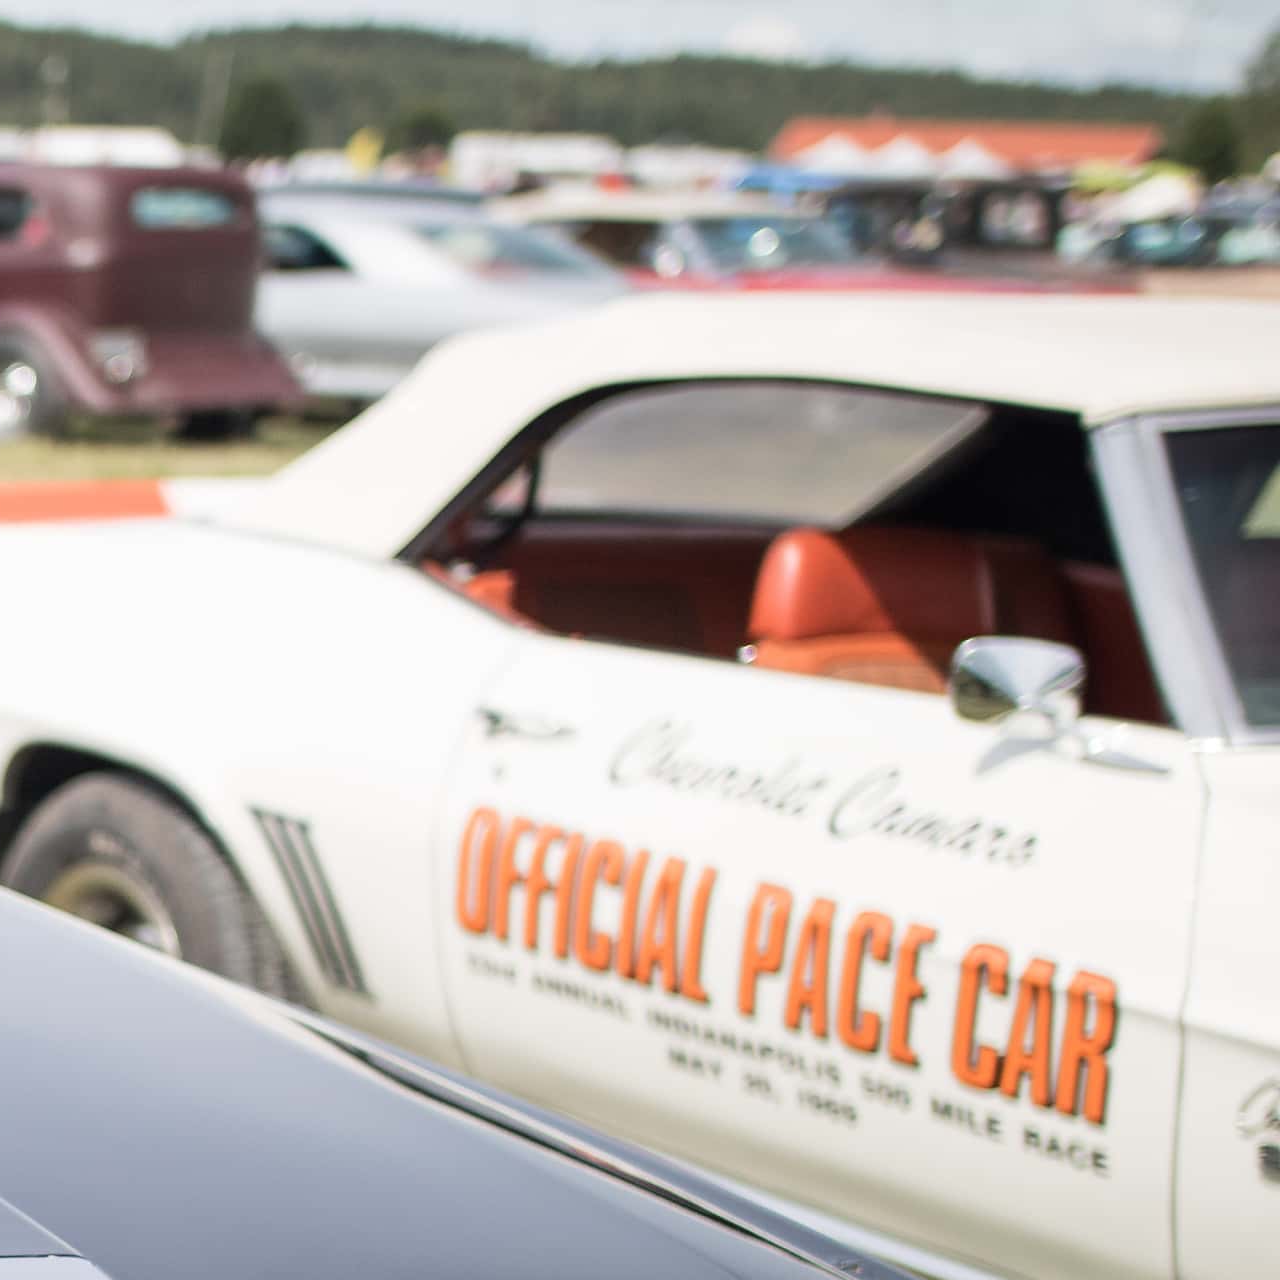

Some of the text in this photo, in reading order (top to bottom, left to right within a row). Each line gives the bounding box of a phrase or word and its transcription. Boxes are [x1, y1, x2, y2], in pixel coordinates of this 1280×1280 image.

[827, 767, 1038, 867] Camaro
[456, 806, 1118, 1126] OFFICIAL PACE CAR
[648, 1009, 840, 1084] INDIANAPOLIS
[860, 1071, 912, 1110] 500
[930, 1097, 1004, 1139] MILE
[1024, 1127, 1111, 1177] RACE
[668, 1047, 722, 1080] MAY
